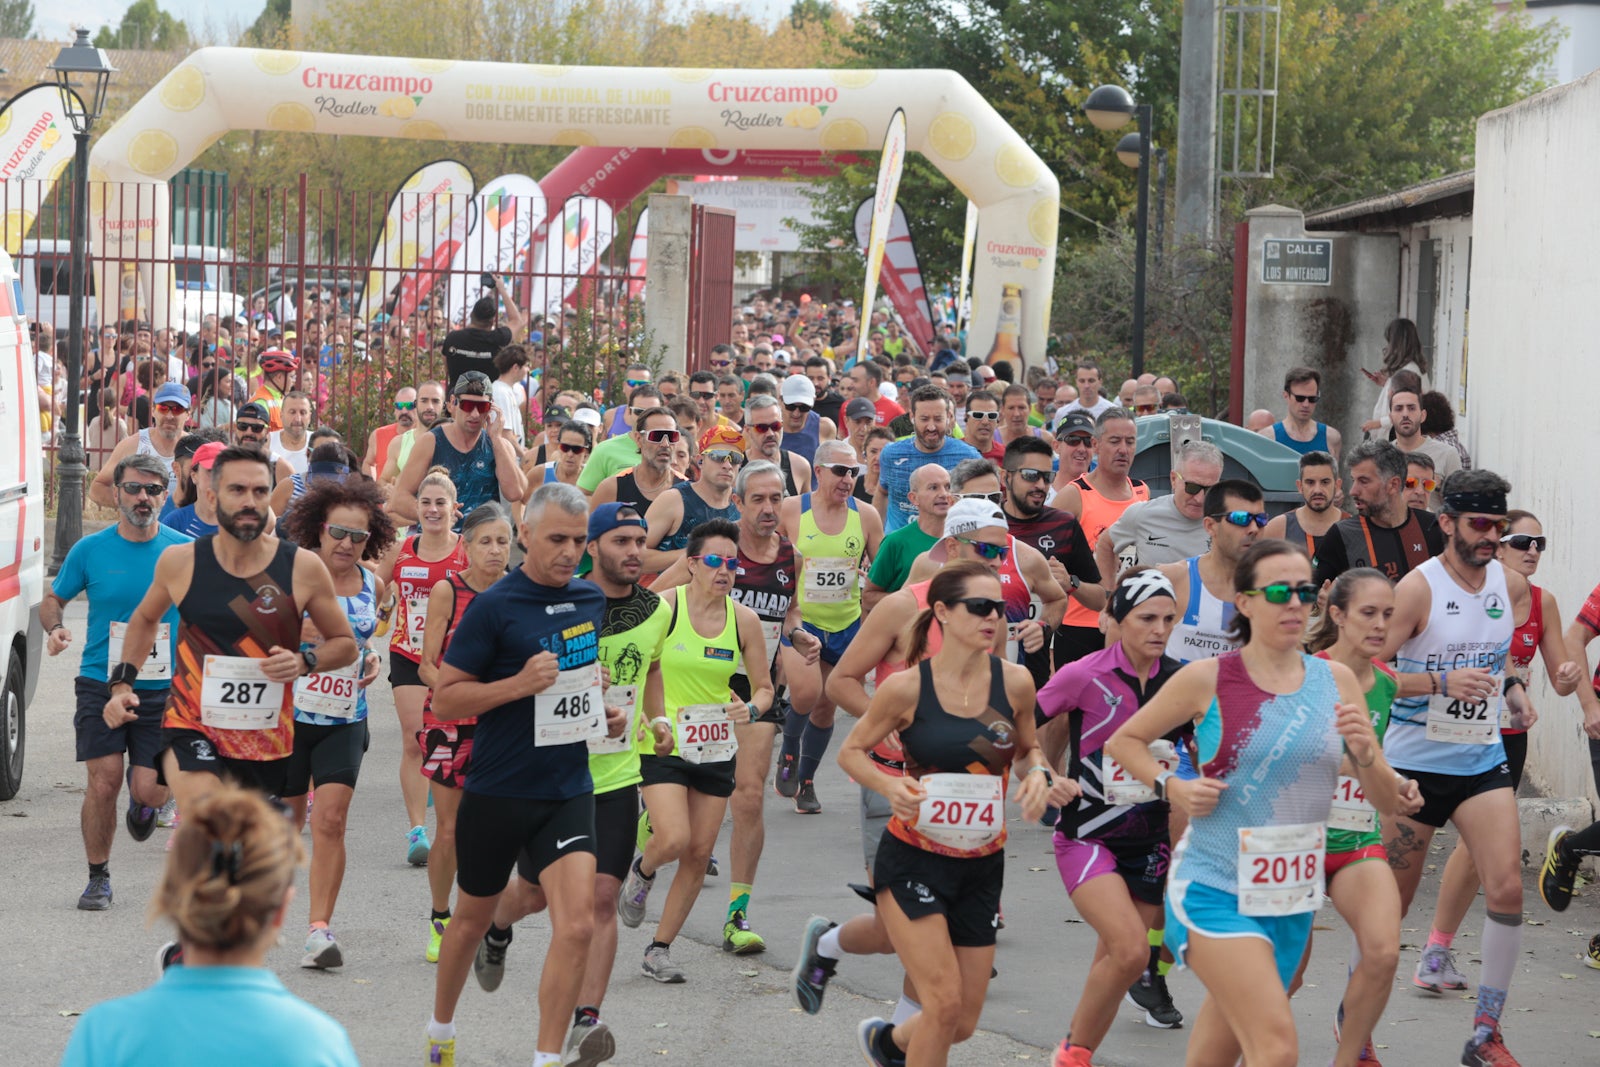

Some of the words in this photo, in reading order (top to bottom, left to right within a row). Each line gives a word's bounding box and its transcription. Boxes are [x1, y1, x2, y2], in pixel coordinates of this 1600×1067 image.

[302, 66, 433, 96] Cruzcampo
[465, 83, 492, 100] CON
[496, 84, 536, 102] ZUMO
[540, 86, 601, 104] NATURAL
[606, 88, 622, 105] DE
[707, 81, 839, 106] Cruzcampo
[314, 94, 378, 118] Radler
[465, 102, 564, 124] DOBLEMENTE
[568, 105, 671, 126] REFRESCANTE
[720, 108, 784, 131] Radler
[986, 240, 1047, 258] Cruzcampo
[1286, 244, 1324, 255] CALLE
[816, 572, 846, 586] 526
[732, 588, 792, 612] RANAD
[562, 620, 596, 640] MEMORIAL
[565, 631, 597, 654] PADRE
[1183, 636, 1221, 651] PAZITO
[1222, 643, 1230, 651] a
[1446, 642, 1467, 652] CLUB
[557, 645, 599, 671] RCELIN
[1425, 653, 1445, 672] EL
[220, 682, 268, 705] 287
[306, 673, 353, 698] 2063
[554, 692, 590, 719] 486
[1446, 700, 1488, 720] 492
[685, 722, 729, 744] 2005
[929, 800, 994, 827] 2074
[1251, 853, 1317, 884] 2018
